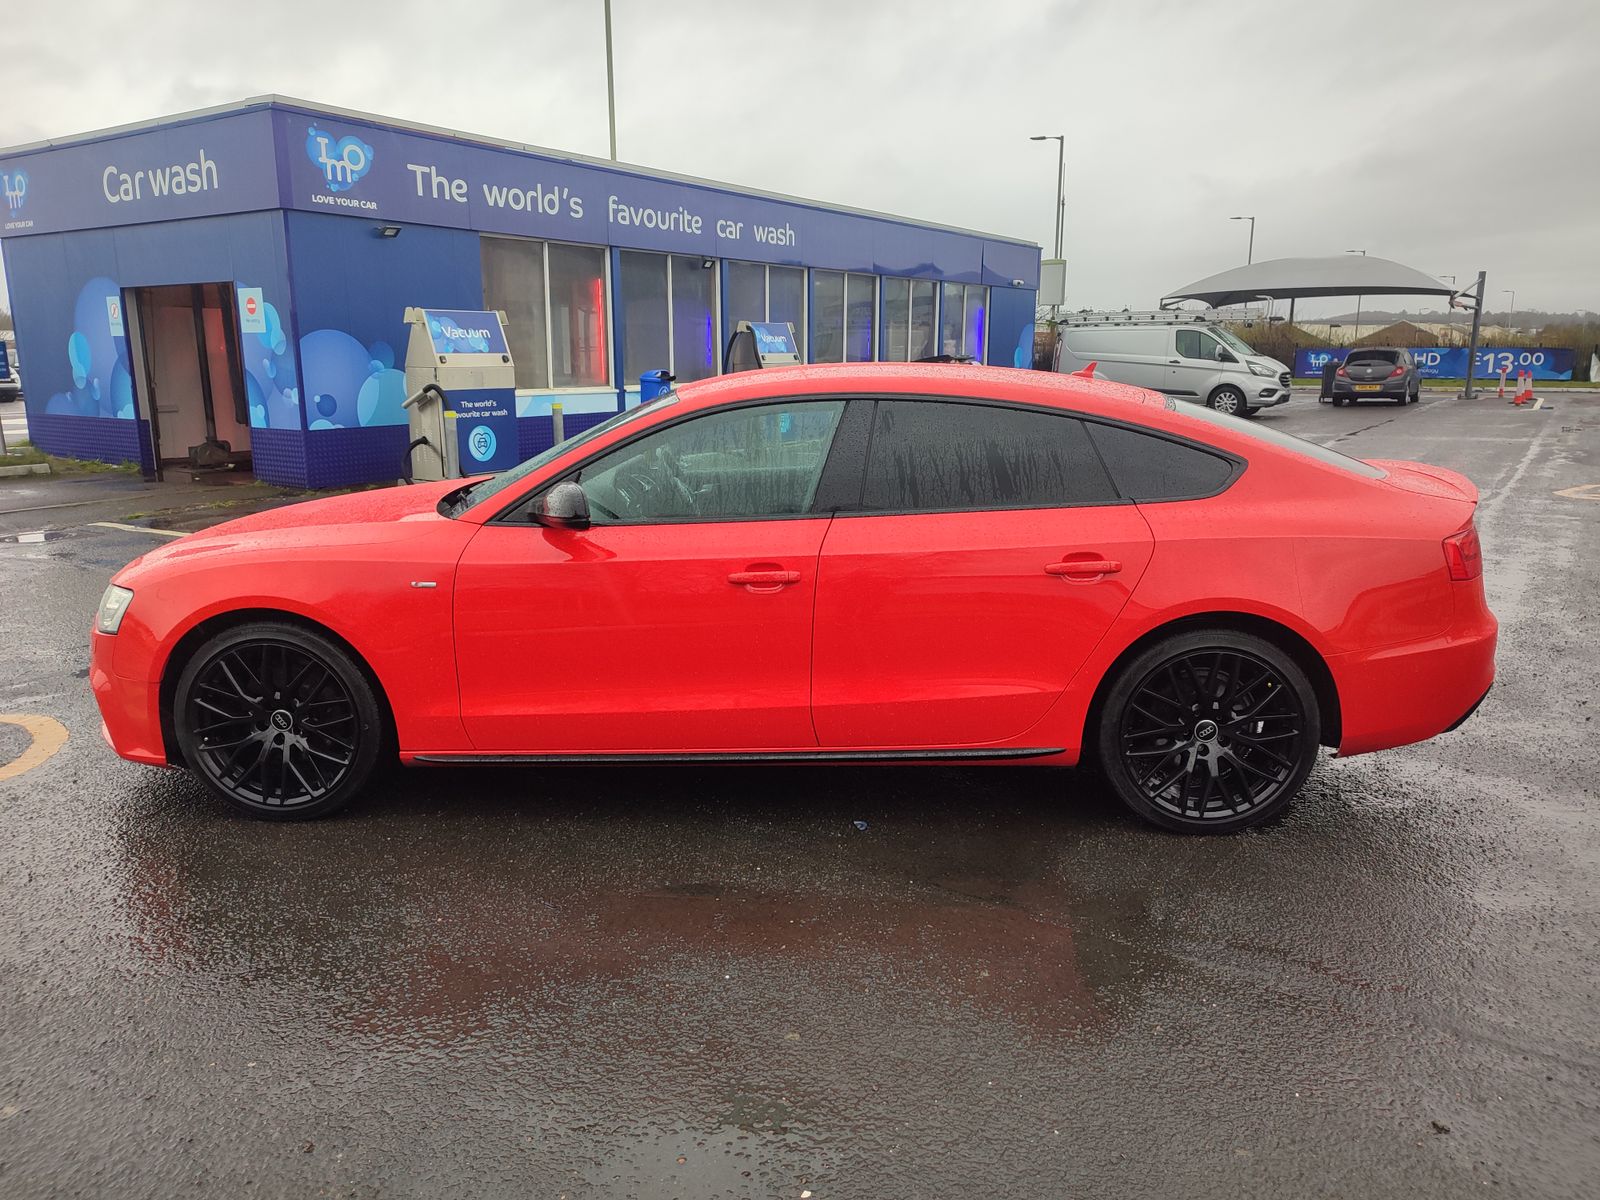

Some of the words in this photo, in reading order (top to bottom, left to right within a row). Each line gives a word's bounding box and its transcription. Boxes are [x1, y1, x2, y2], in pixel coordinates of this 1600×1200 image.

[103, 165, 145, 203] Car
[148, 148, 219, 197] wash
[311, 194, 335, 205] LOVE
[335, 197, 360, 208] YOUR
[360, 201, 378, 210] CAR
[406, 163, 469, 203] The
[482, 183, 584, 219] world's
[608, 195, 703, 235] favourite
[716, 219, 744, 240] car
[753, 223, 796, 247] wash
[441, 326, 491, 339] Vacuum
[760, 332, 788, 343] Vacuum
[1414, 352, 1441, 366] HD
[474, 400, 497, 408] world's
[491, 409, 508, 417] wash
